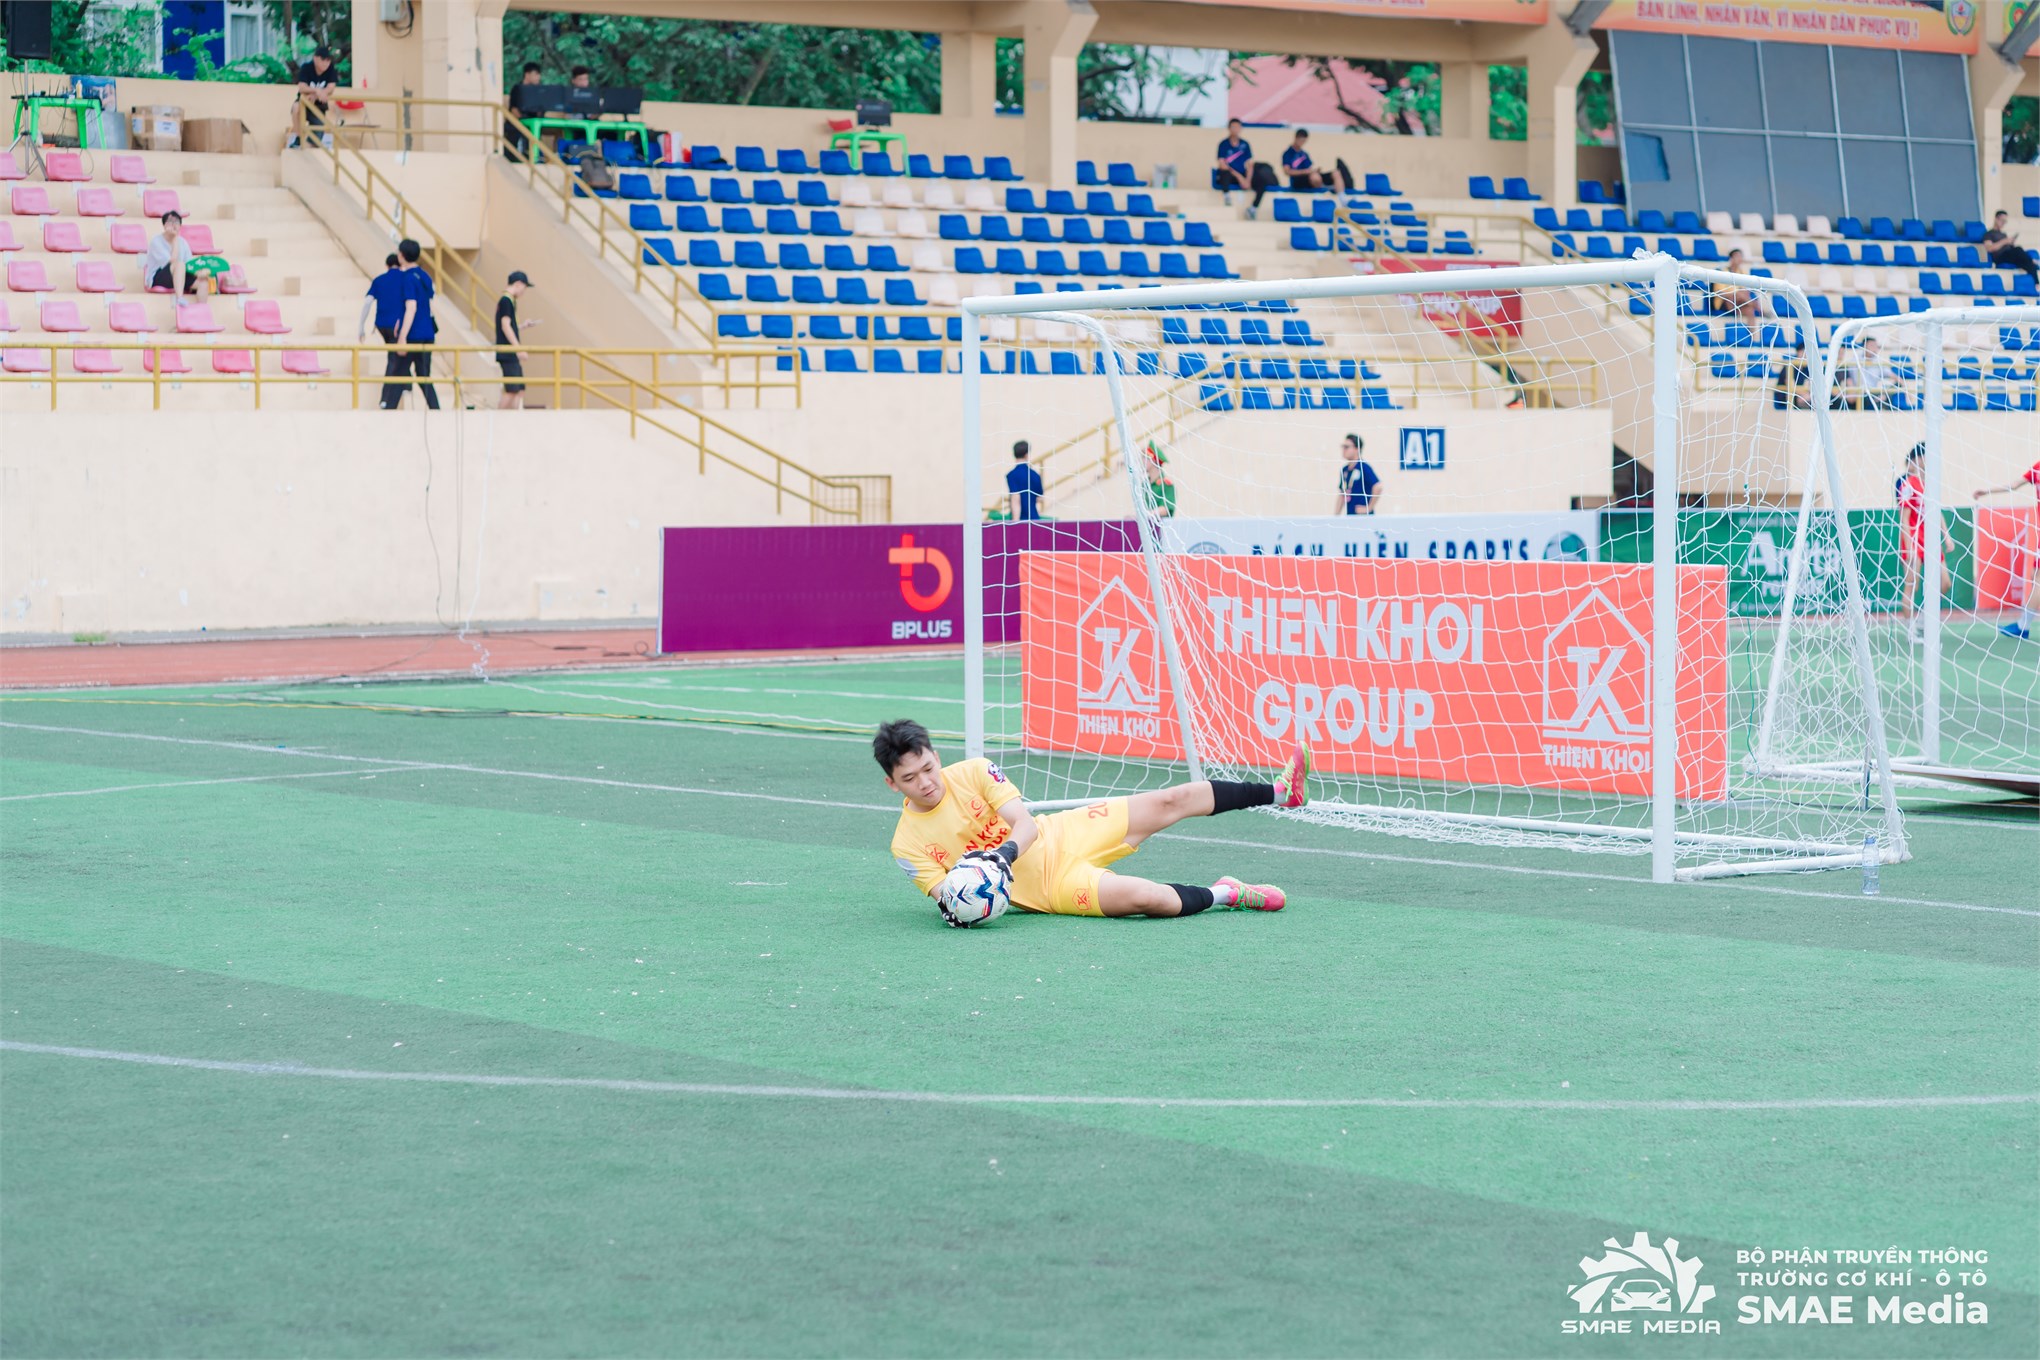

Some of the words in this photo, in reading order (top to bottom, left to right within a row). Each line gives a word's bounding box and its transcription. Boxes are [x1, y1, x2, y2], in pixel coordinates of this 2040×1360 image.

[1405, 431, 1440, 466] A1
[891, 619, 953, 640] BPLUS
[1356, 600, 1484, 664] KHOI
[1123, 717, 1161, 739] KHOI
[1253, 680, 1435, 748] GROUP
[1602, 748, 1650, 773] KHOI
